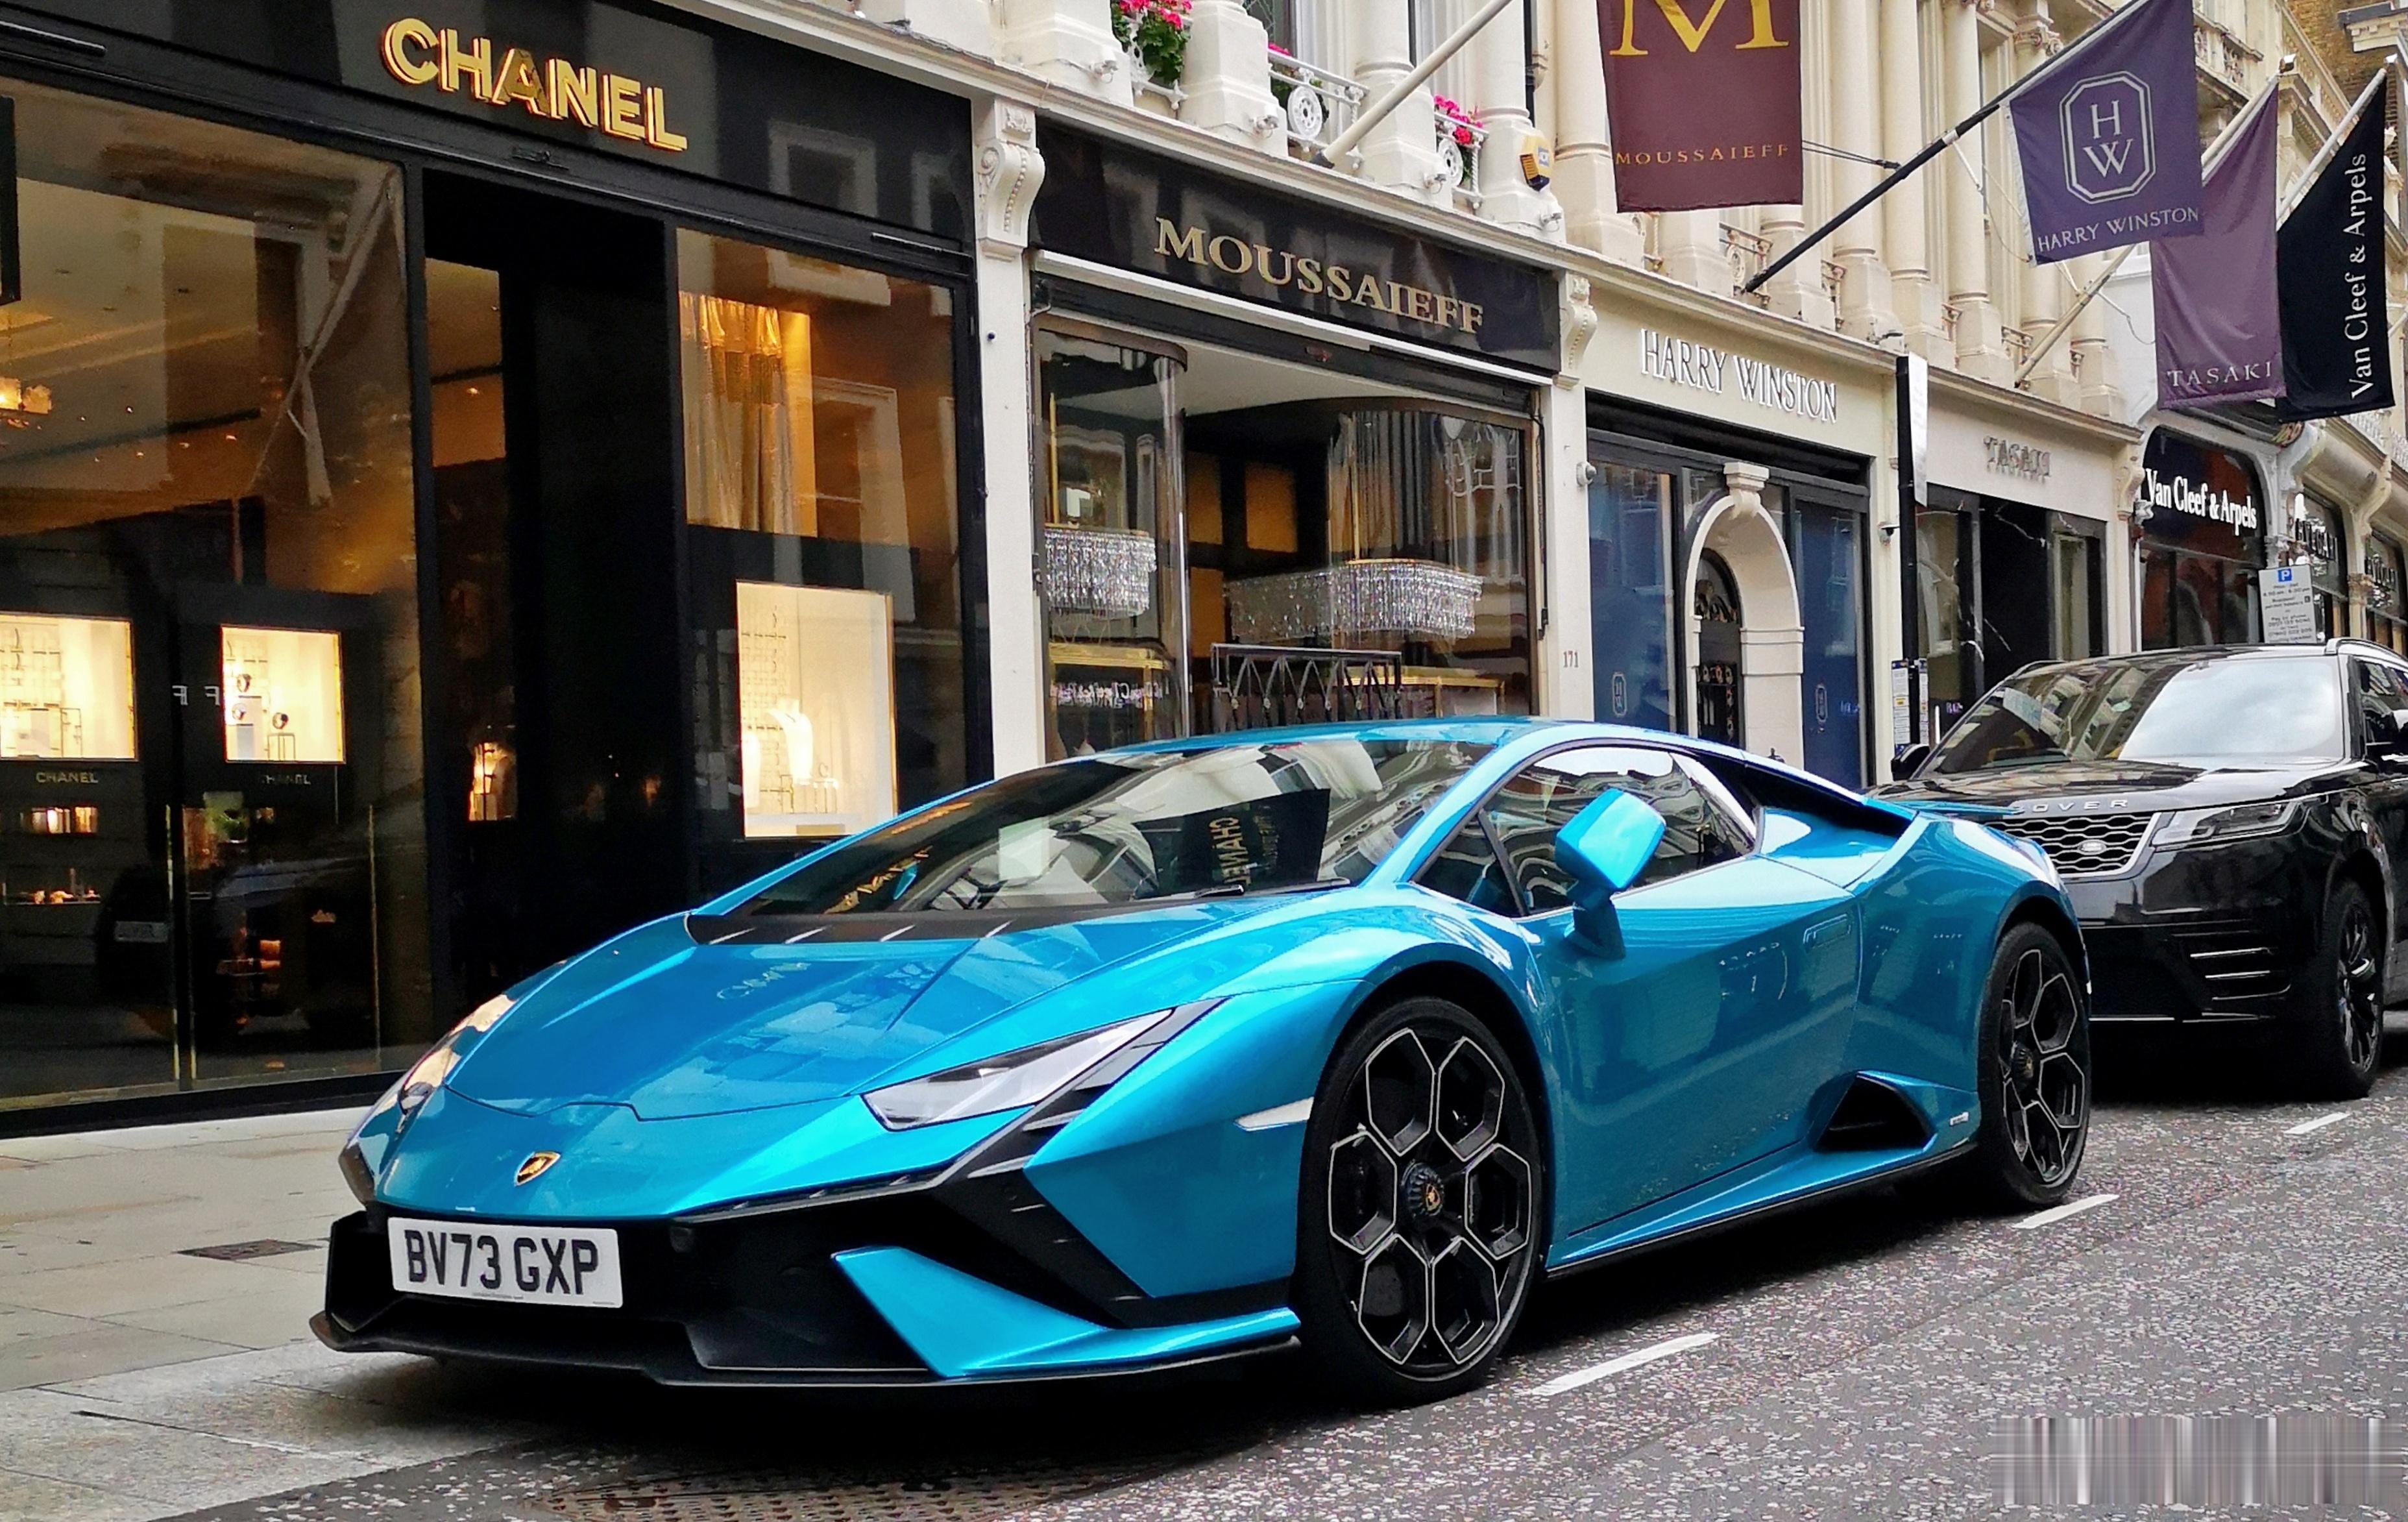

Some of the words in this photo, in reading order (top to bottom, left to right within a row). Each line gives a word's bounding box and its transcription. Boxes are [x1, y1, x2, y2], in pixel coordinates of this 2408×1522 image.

[382, 17, 688, 152] CHANEL
[2091, 100, 2122, 139] H
[1616, 144, 1788, 165] MOUSSAIEFF
[2083, 139, 2133, 177] W
[2343, 154, 2372, 236] Arpels
[2037, 223, 2100, 252] HARRY
[2106, 207, 2198, 234] WINSTON
[1154, 216, 1484, 334] MOUSSAIEFF
[2350, 245, 2366, 264] &
[2344, 273, 2368, 340] Cleef
[1640, 328, 1727, 394] HARRY
[1733, 355, 1836, 423] WINSTON
[2167, 362, 2270, 386] TASAKI
[2349, 347, 2374, 399] Van
[2146, 468, 2172, 508] Van
[2174, 476, 2208, 517] Cleef
[2209, 493, 2219, 520] &
[2220, 490, 2257, 536] Arpels
[1563, 650, 1579, 668] 171
[36, 771, 99, 783] CHANEL
[404, 1230, 502, 1290] BV73
[514, 1237, 599, 1295] GXP
